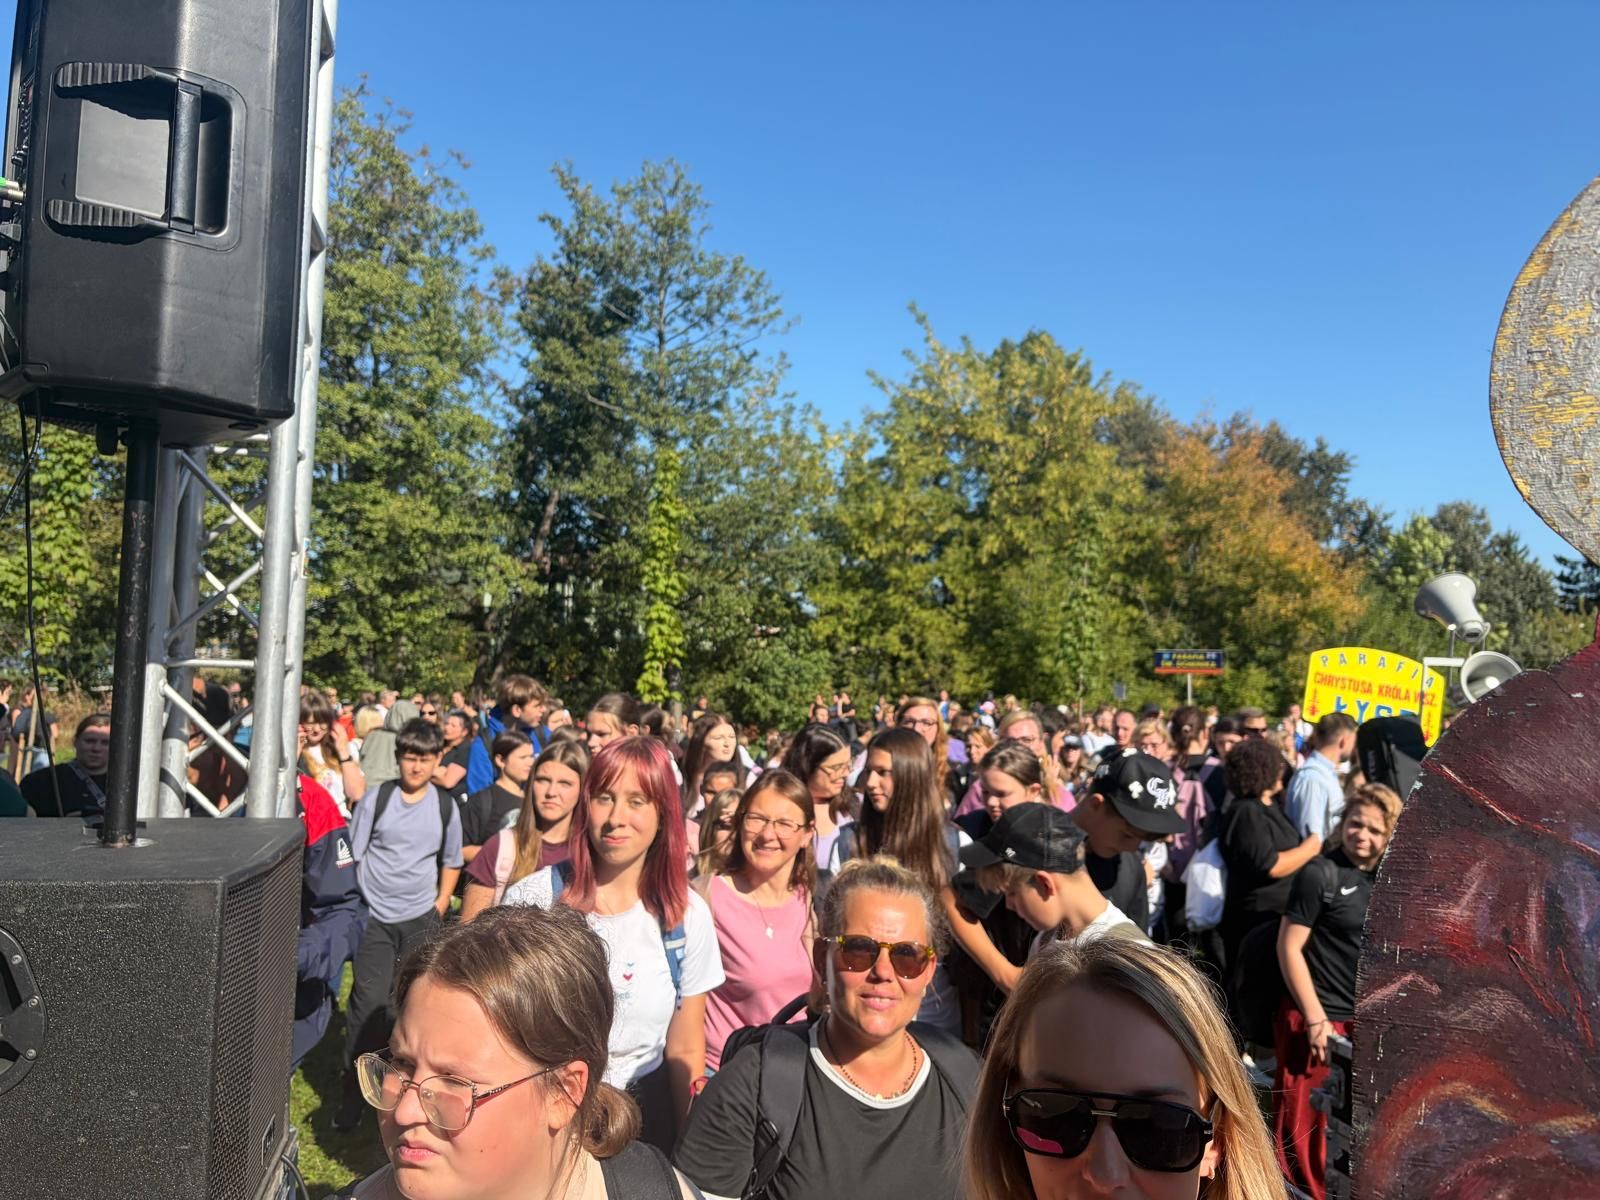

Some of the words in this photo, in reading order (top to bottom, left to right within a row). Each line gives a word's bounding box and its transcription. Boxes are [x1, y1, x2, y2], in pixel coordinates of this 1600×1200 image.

[1320, 653, 1434, 688] PARAFIA
[1314, 672, 1373, 695] CHRYSTUSA
[1378, 683, 1410, 702] KRÓLA
